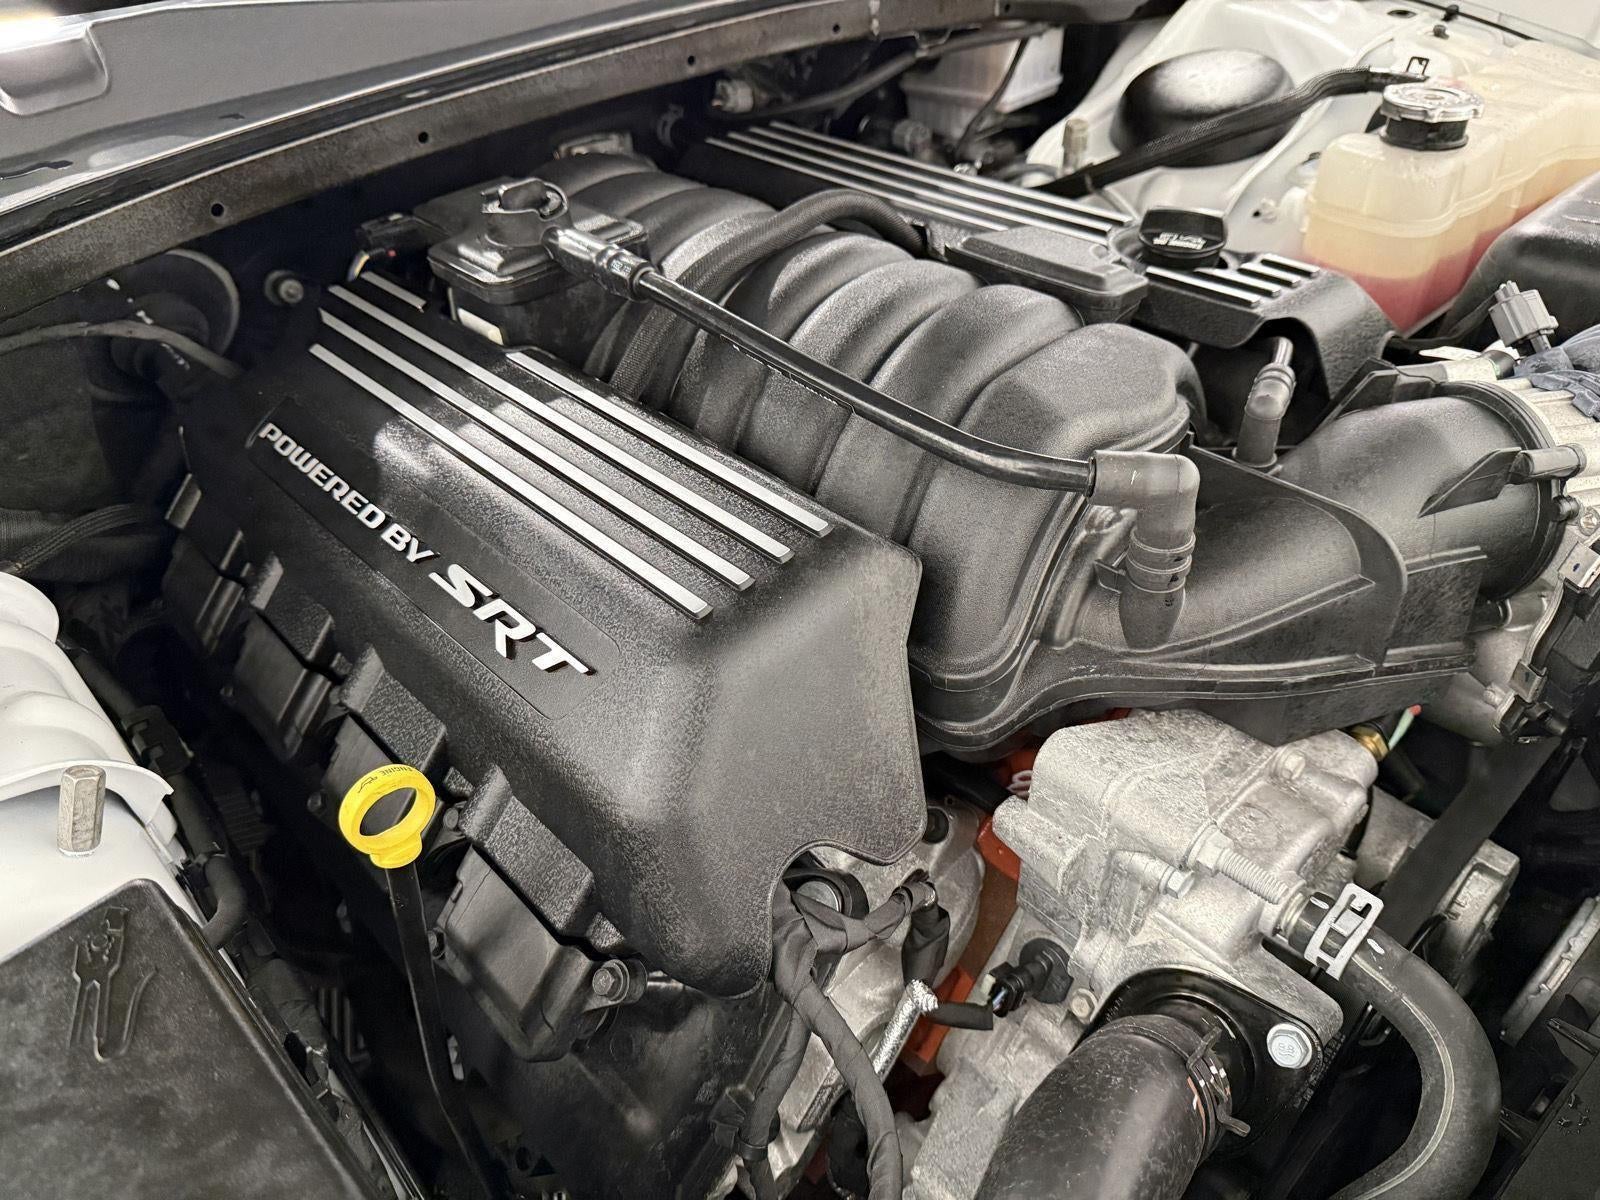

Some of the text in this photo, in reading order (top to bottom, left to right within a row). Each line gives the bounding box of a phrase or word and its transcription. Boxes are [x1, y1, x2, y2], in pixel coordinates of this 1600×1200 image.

[259, 422, 589, 674] POWERED BY SRT
[380, 767, 413, 776] ENGINE
